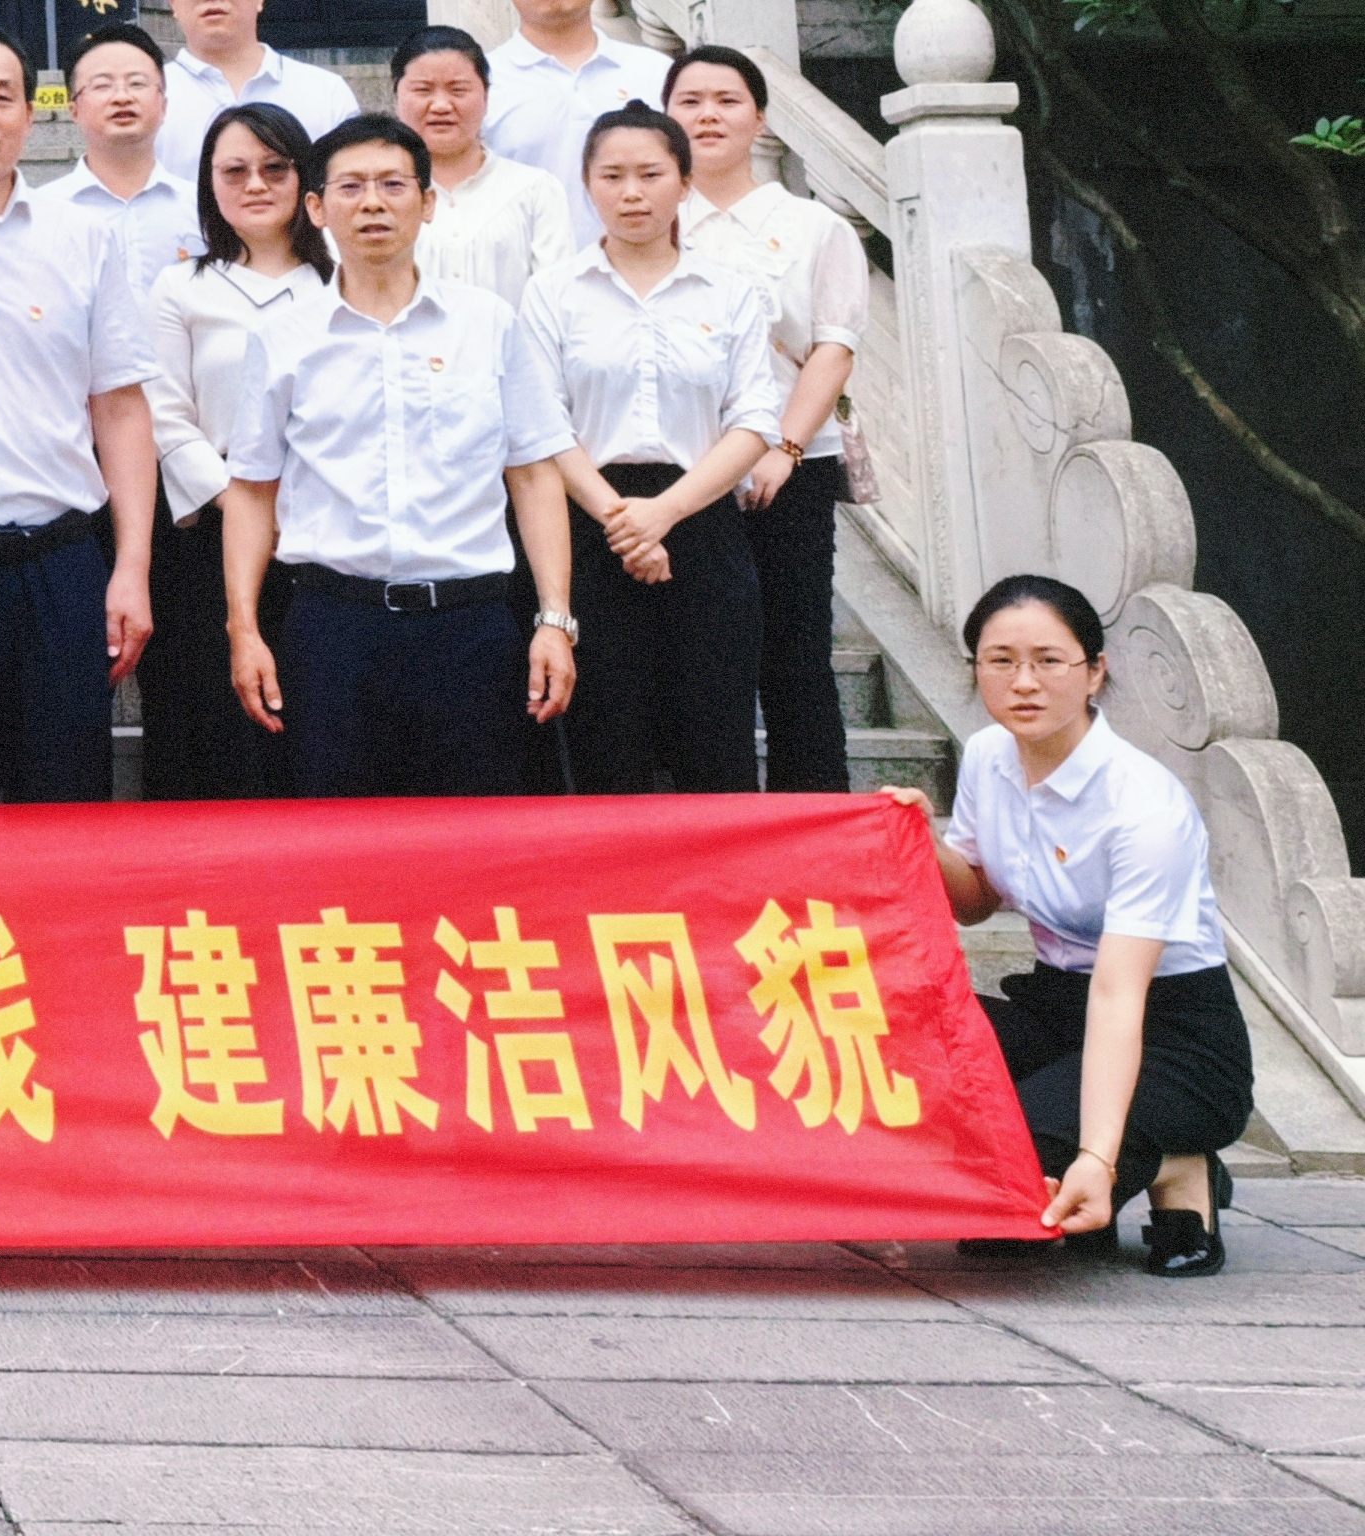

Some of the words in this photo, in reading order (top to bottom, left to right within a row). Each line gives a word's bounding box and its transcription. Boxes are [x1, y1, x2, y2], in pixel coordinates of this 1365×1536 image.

[123, 897, 920, 1139] 建廉洁风貌
